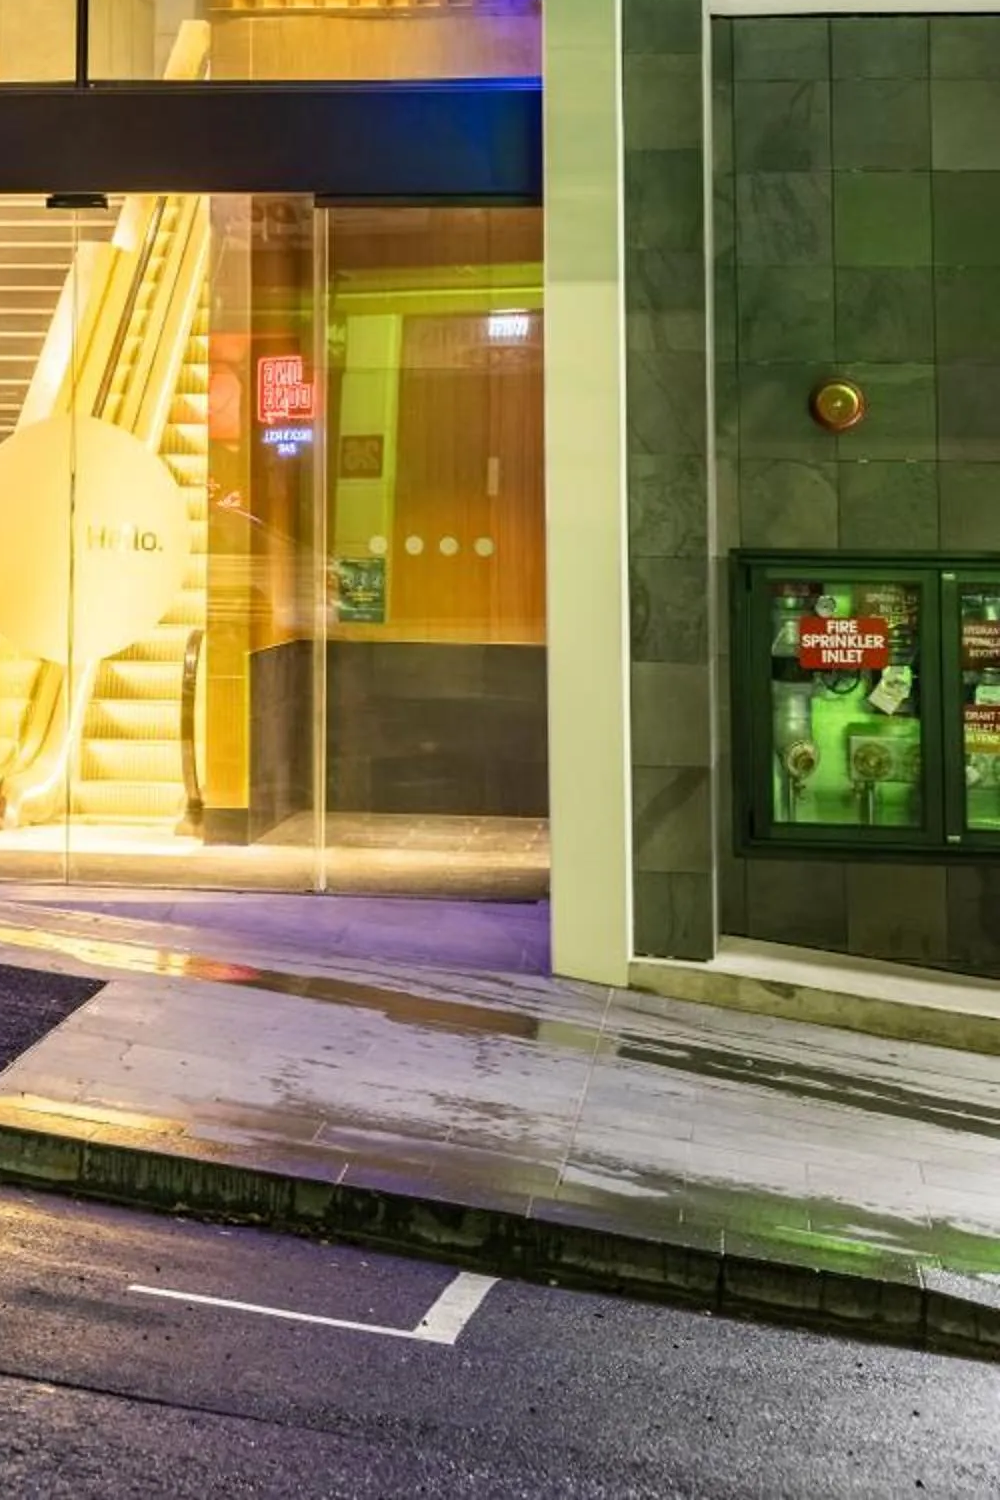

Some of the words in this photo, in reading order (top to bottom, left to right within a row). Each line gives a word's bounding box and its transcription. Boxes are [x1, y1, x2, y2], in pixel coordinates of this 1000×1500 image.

[86, 524, 163, 552] Helo.
[827, 619, 858, 634] FIRE
[802, 634, 885, 649] SPRINKLER
[821, 650, 864, 663] INLET
